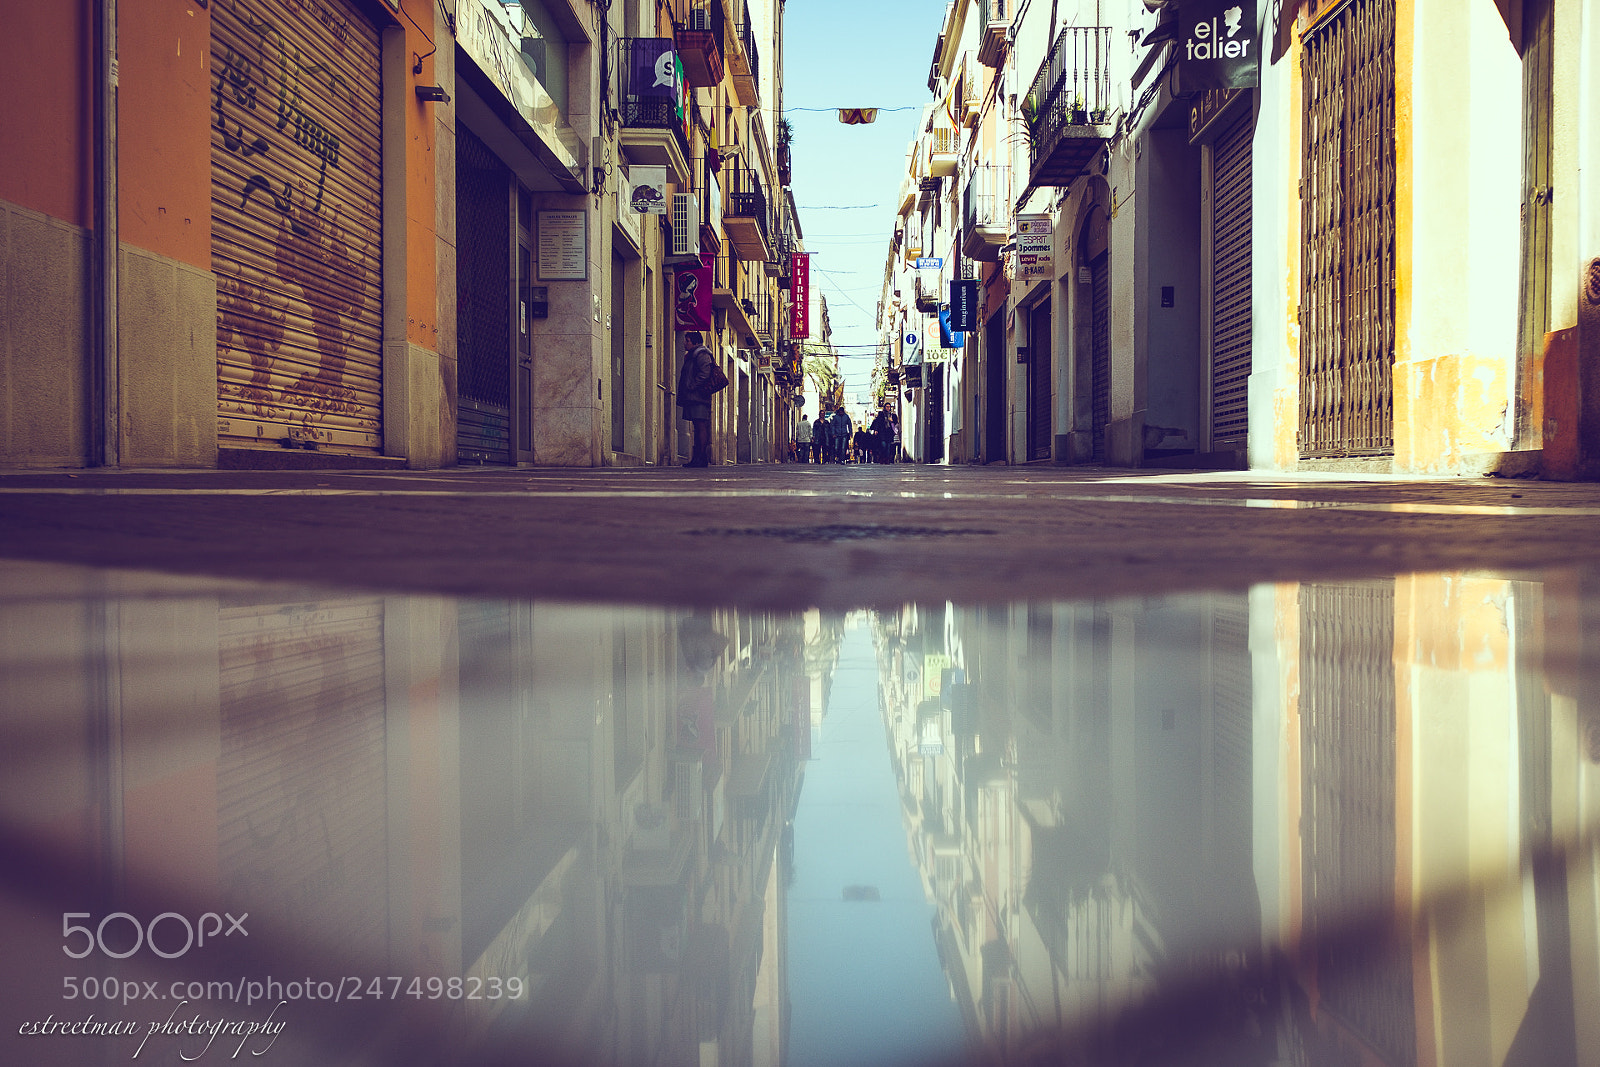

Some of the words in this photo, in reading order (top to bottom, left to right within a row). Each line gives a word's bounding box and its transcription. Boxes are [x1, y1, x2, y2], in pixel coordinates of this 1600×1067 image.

[1185, 35, 1251, 60] talier
[1018, 244, 1023, 252] 3
[1022, 244, 1051, 253] pommes
[1023, 235, 1048, 244] ESPRIT
[796, 259, 805, 319] LLIBRES
[960, 285, 968, 327] Imaginarium
